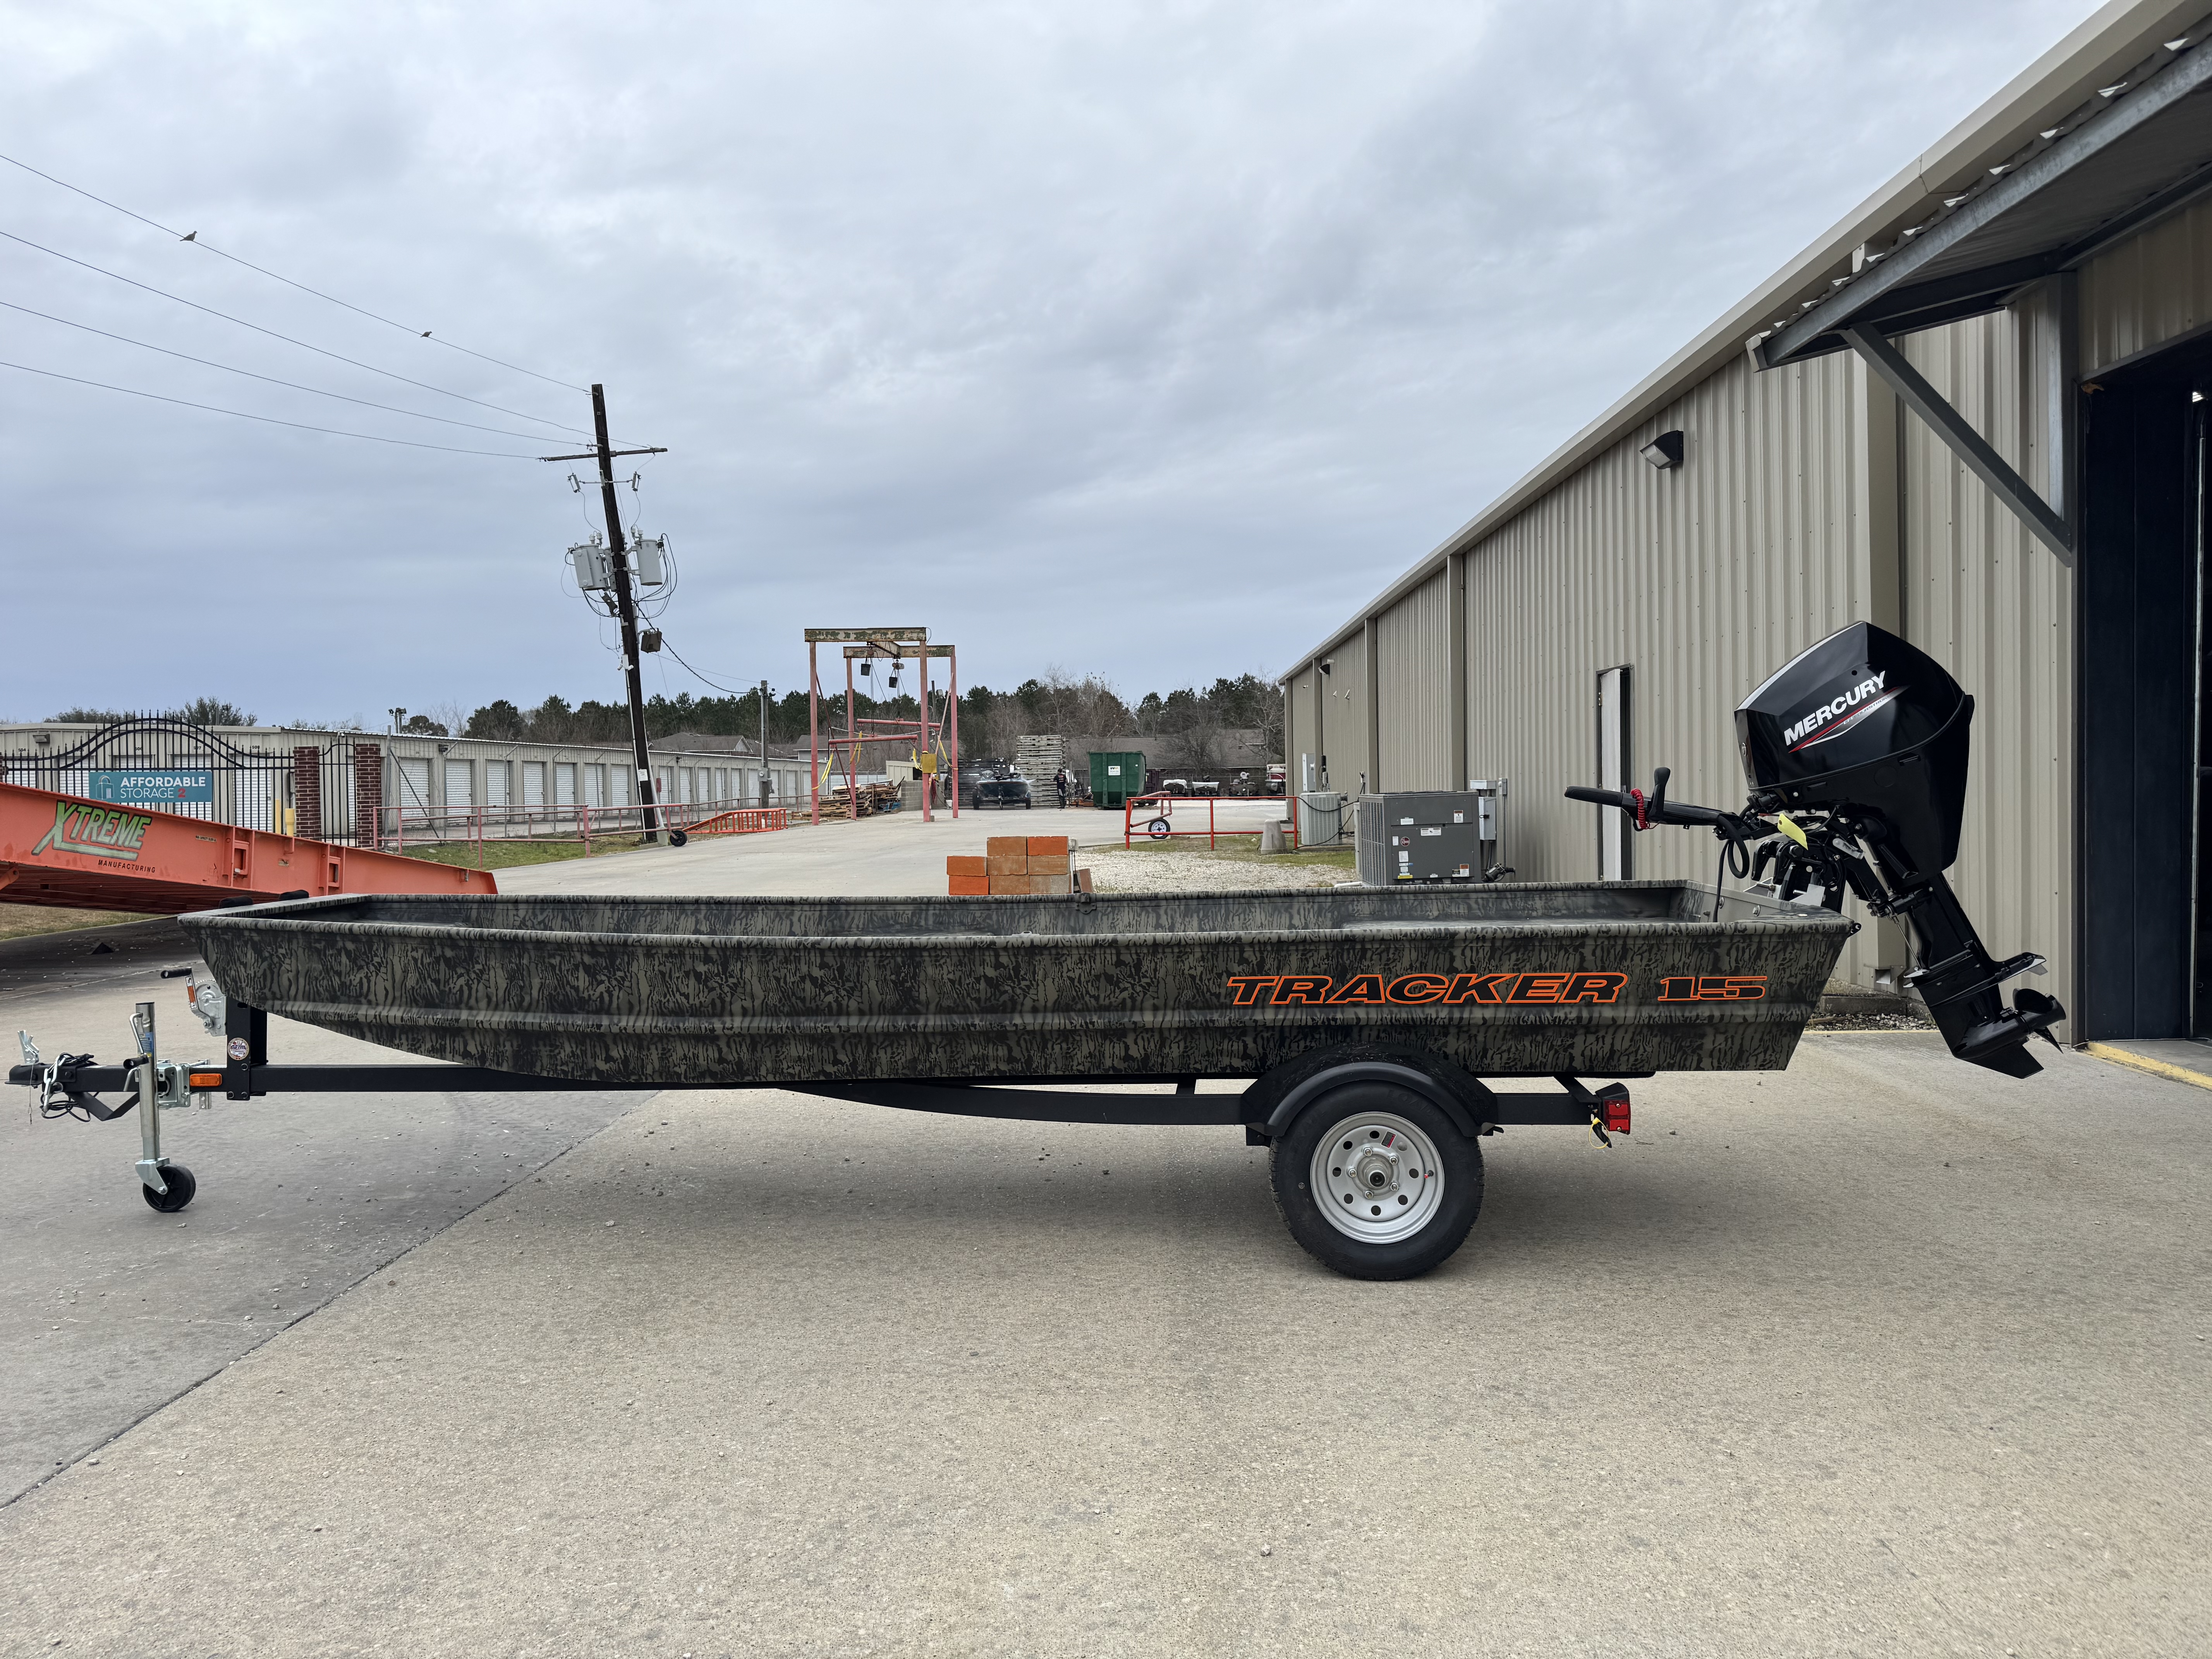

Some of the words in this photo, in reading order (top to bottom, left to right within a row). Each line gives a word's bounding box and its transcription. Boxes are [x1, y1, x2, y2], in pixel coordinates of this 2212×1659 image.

[1784, 671, 1885, 745] MERCURY
[120, 777, 206, 787] AFFORDABLE
[120, 788, 174, 798] STORAGE
[178, 788, 186, 798] 2
[31, 799, 152, 861] XTREME
[98, 859, 155, 872] MANUFACTURING
[1227, 972, 1628, 1005] TRACKER
[1658, 976, 1767, 1001] 15
